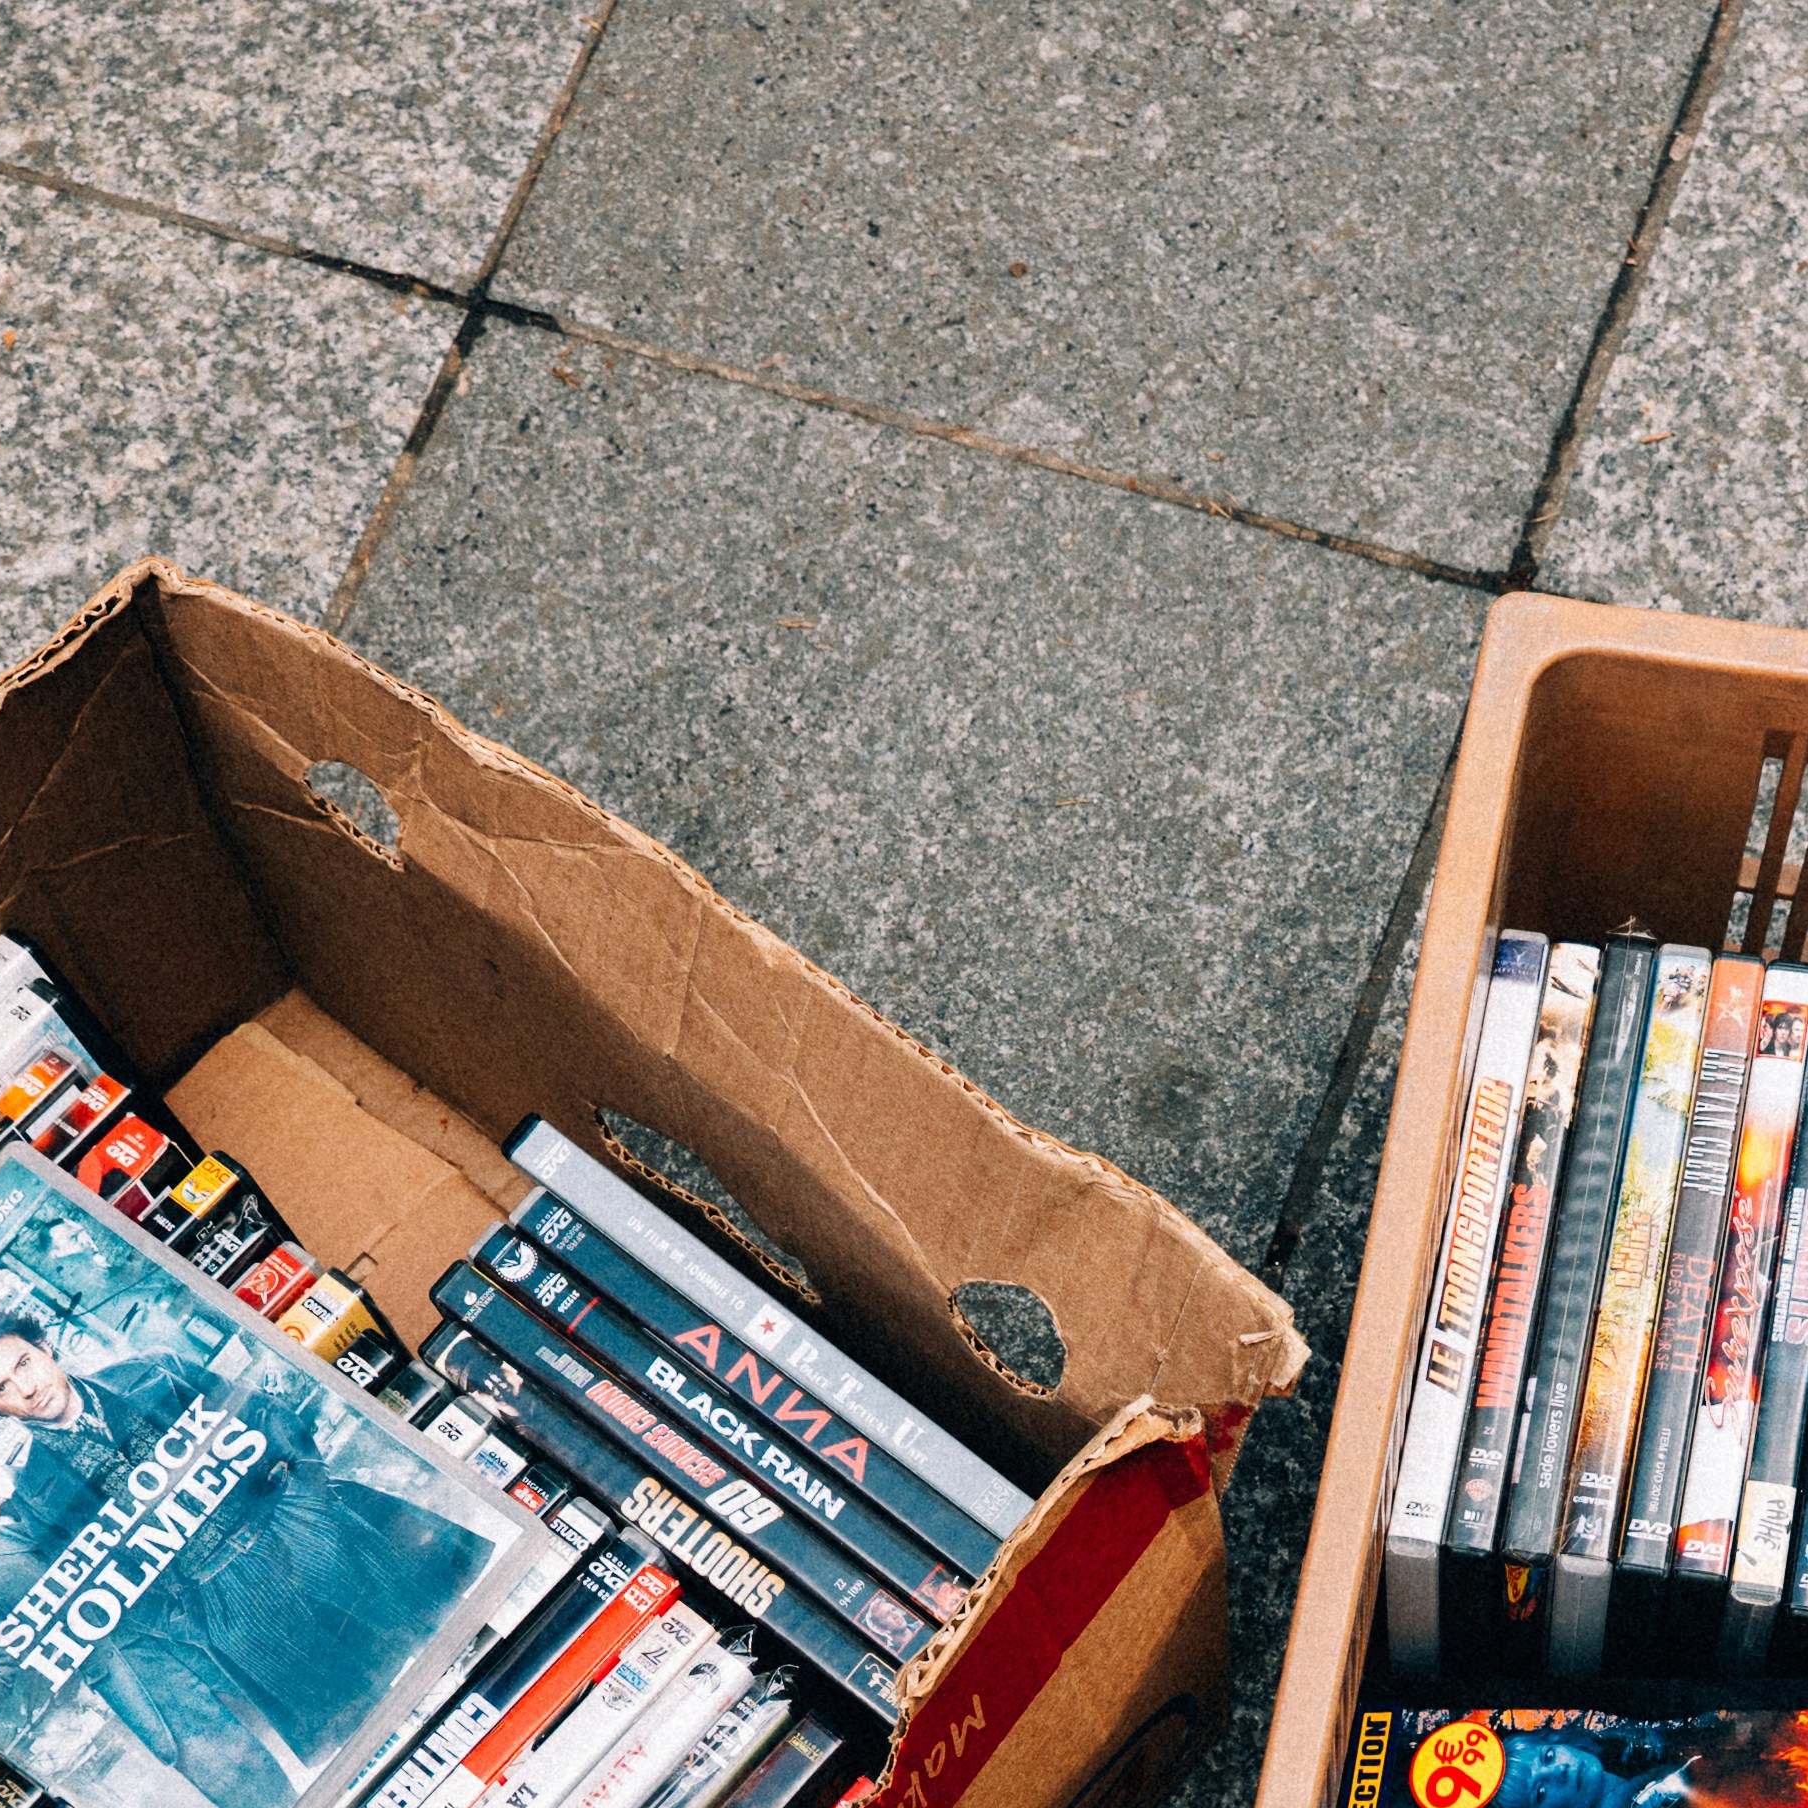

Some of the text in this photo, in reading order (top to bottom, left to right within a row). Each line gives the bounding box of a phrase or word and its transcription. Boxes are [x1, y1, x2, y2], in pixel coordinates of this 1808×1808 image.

[1423, 1075, 1513, 1390] LE TRANSPORTEUR
[1473, 1180, 1550, 1412] WINDTALKERS
[1667, 1252, 1717, 1375] DEATH
[644, 1355, 768, 1459] BLACK
[755, 1443, 847, 1523] RAIN
[1537, 1381, 1570, 1489] sade lovers live
[23, 1412, 268, 1695] HOLMES
[548, 1513, 589, 1556] STUDIO
[619, 1473, 786, 1618] SHOOTERS
